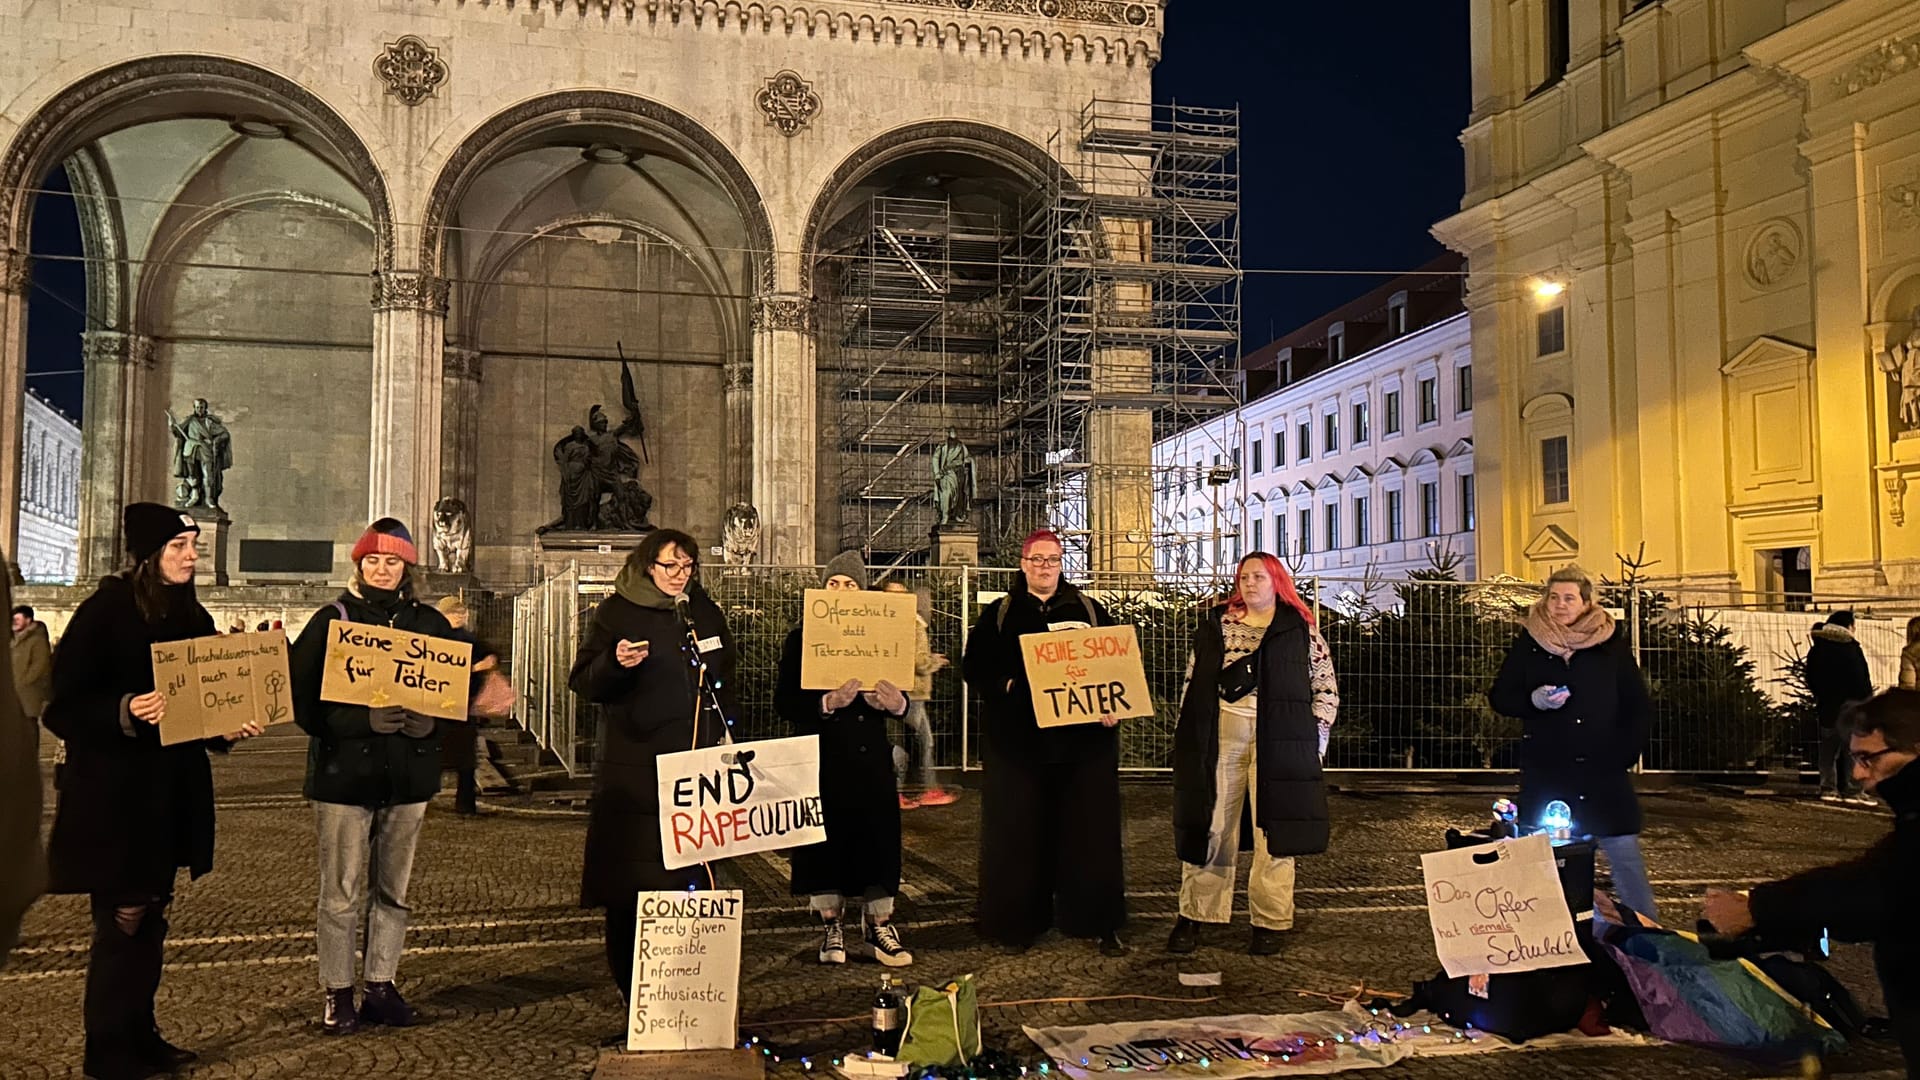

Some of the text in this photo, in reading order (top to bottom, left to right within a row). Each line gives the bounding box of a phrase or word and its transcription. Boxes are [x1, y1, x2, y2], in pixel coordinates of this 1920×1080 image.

[812, 599, 897, 625] Opferschutz
[842, 624, 866, 637] statt
[154, 650, 179, 664] Die
[338, 626, 467, 668] Keine Show
[811, 642, 899, 658] Täterschutz!
[1034, 636, 1132, 664] KEINE SHOW
[168, 674, 186, 697] gilt
[201, 670, 227, 684] auch
[344, 656, 451, 694] für Täter
[1065, 664, 1088, 680] für
[203, 691, 244, 713] Opfer
[1043, 681, 1132, 718] TÄTER
[673, 751, 755, 808] END
[641, 897, 740, 918] CONSENT
[1432, 880, 1539, 922] Das Opfer
[640, 919, 726, 939] Freely Given
[1437, 919, 1515, 939] hat niemals
[639, 938, 707, 960] Reversible
[639, 961, 702, 982] Informed
[637, 982, 727, 1009] Enthusiastic
[634, 1009, 699, 1036] Specific
